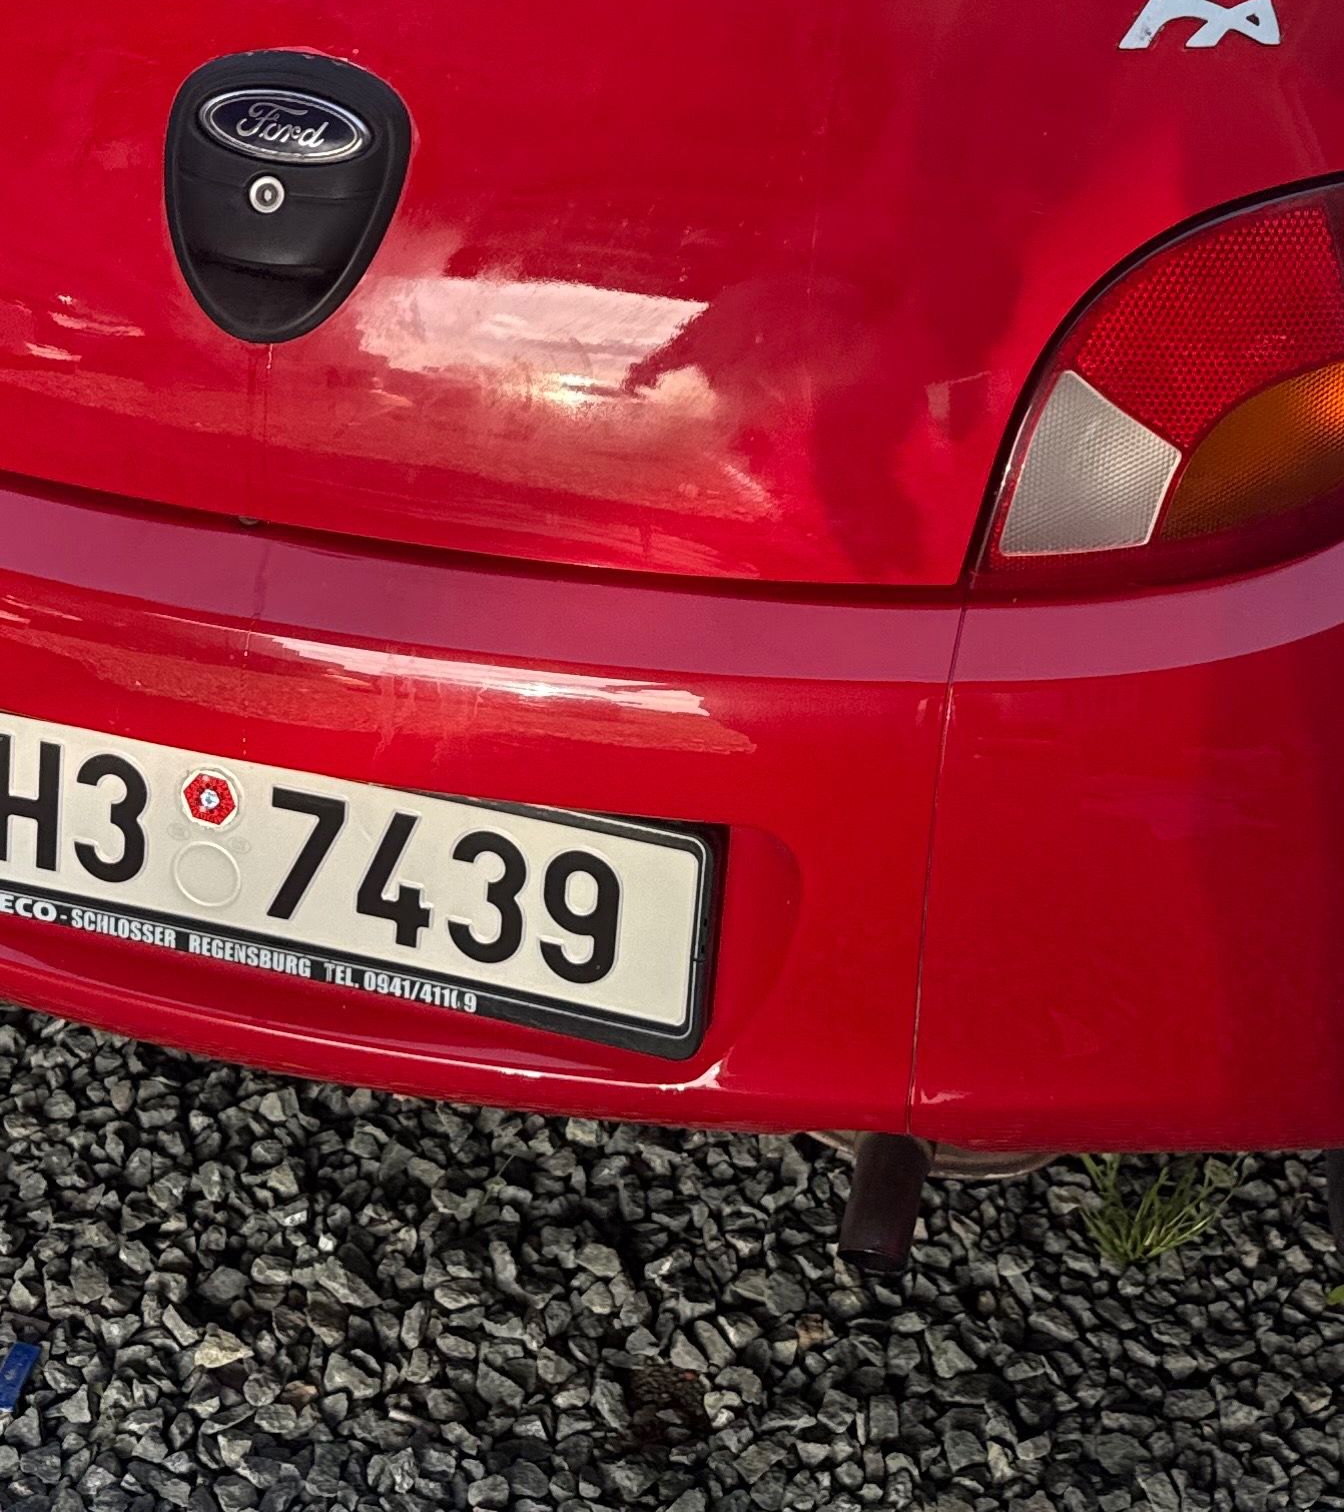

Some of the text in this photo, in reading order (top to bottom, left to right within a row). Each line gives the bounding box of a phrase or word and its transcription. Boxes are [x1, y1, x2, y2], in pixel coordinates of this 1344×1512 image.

[235, 101, 330, 149] Ford
[264, 786, 622, 984] 7439
[188, 934, 312, 979] REGENSBURG
[323, 962, 359, 988] TEL.
